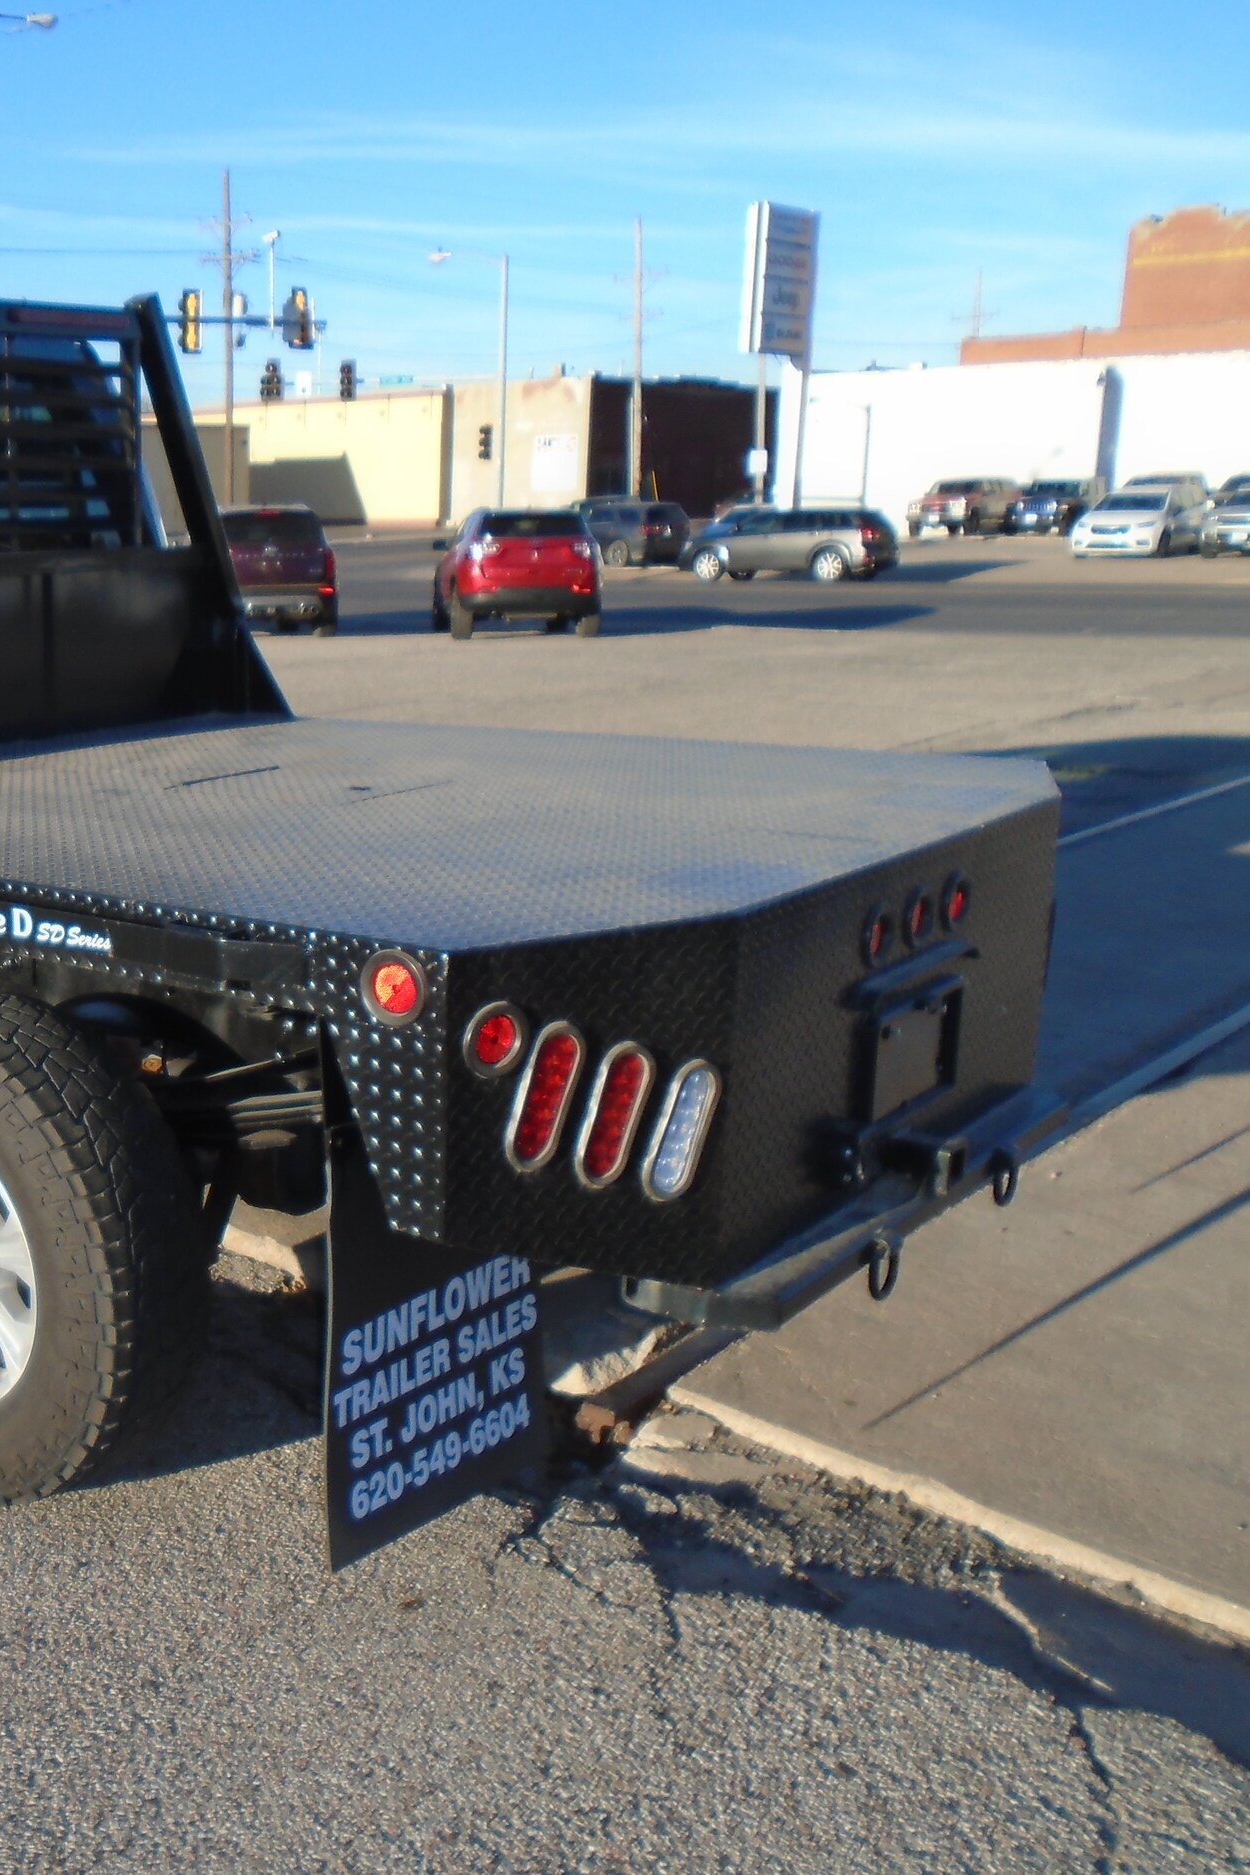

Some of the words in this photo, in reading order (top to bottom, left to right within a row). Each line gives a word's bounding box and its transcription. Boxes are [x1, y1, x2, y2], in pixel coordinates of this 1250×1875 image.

[11, 907, 33, 938] D
[36, 922, 66, 943] SD
[65, 926, 112, 951] Series
[333, 1338, 451, 1429] TRAILER
[457, 1293, 538, 1364] SALES
[341, 1254, 532, 1376] SUNFLOWER
[350, 1393, 531, 1520] 620-549-6604
[351, 1417, 393, 1469] ST.
[401, 1373, 485, 1443] JOHN,
[491, 1347, 526, 1396] KS
